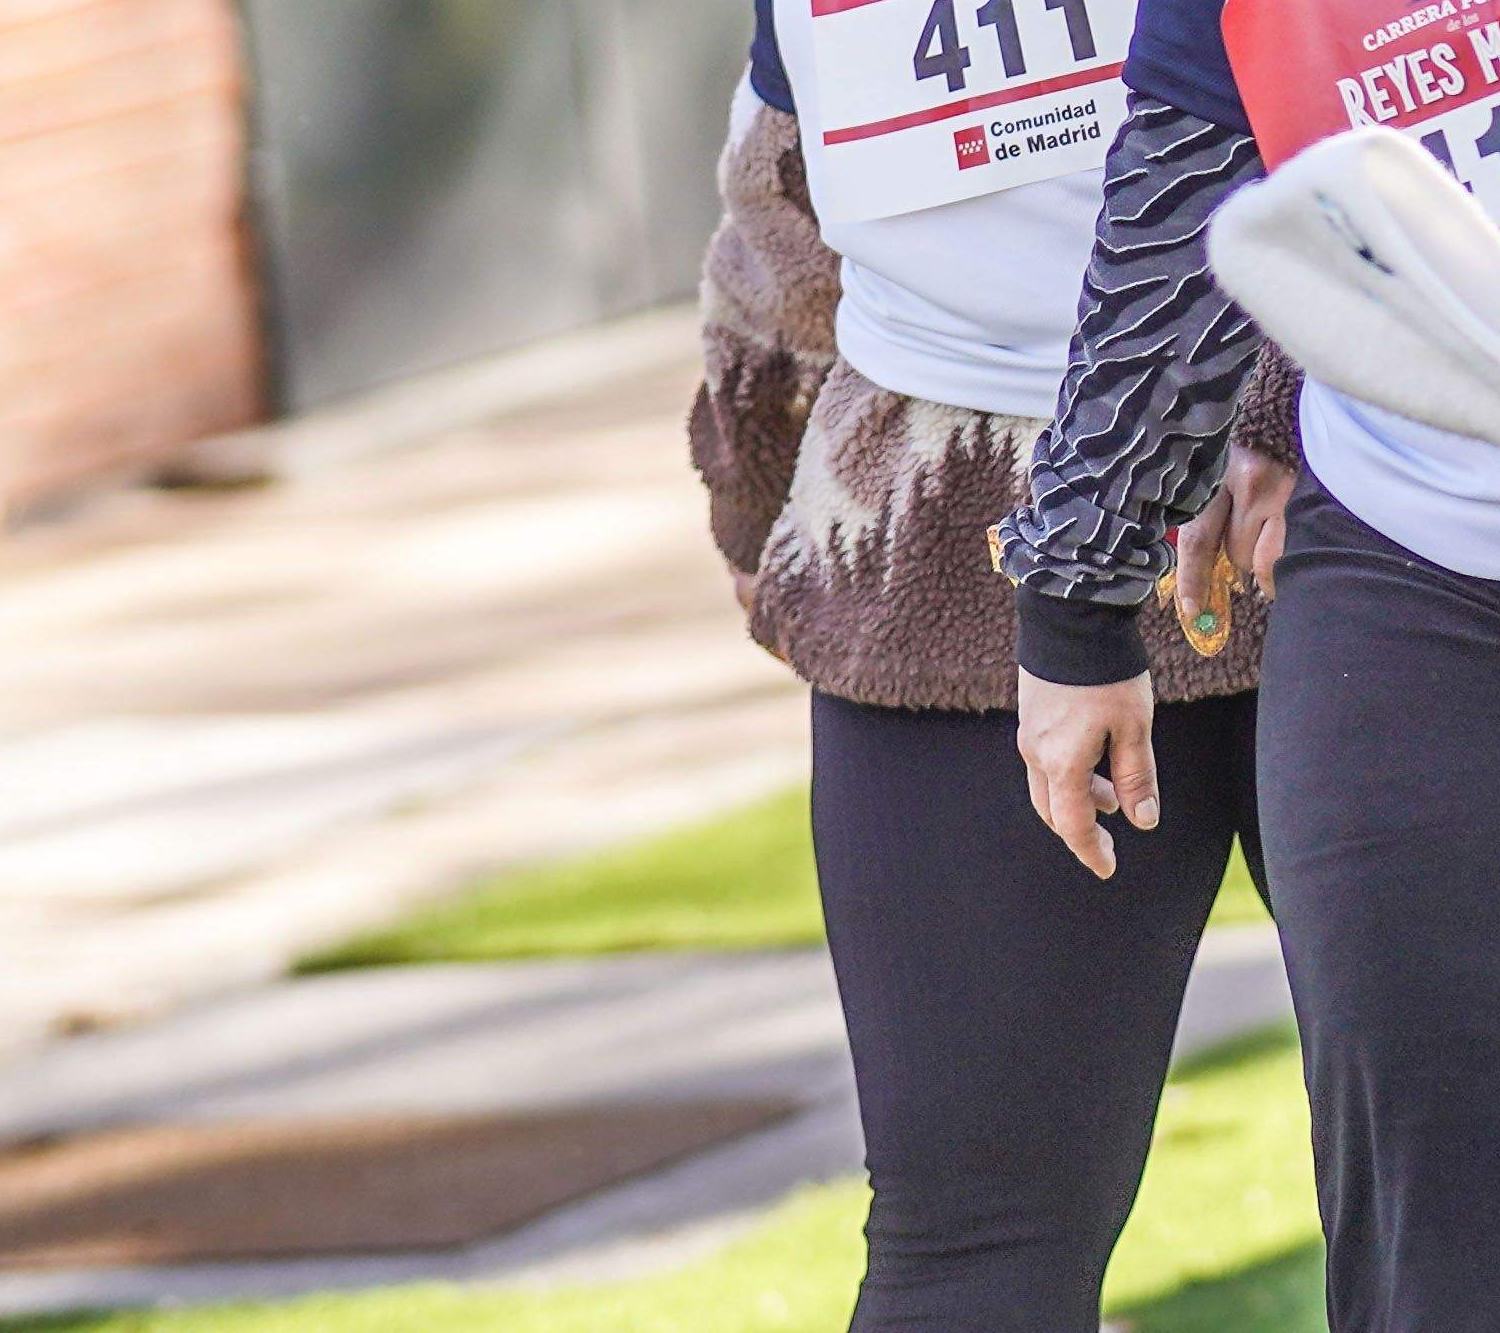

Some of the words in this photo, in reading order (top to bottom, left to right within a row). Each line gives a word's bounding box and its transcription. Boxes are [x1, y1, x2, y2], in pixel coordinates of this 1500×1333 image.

[1362, 0, 1458, 51] CARRERA
[1336, 42, 1465, 131] REYES
[990, 99, 1097, 137] Comunidad
[995, 143, 1021, 160] de
[1026, 121, 1101, 154] Madrid
